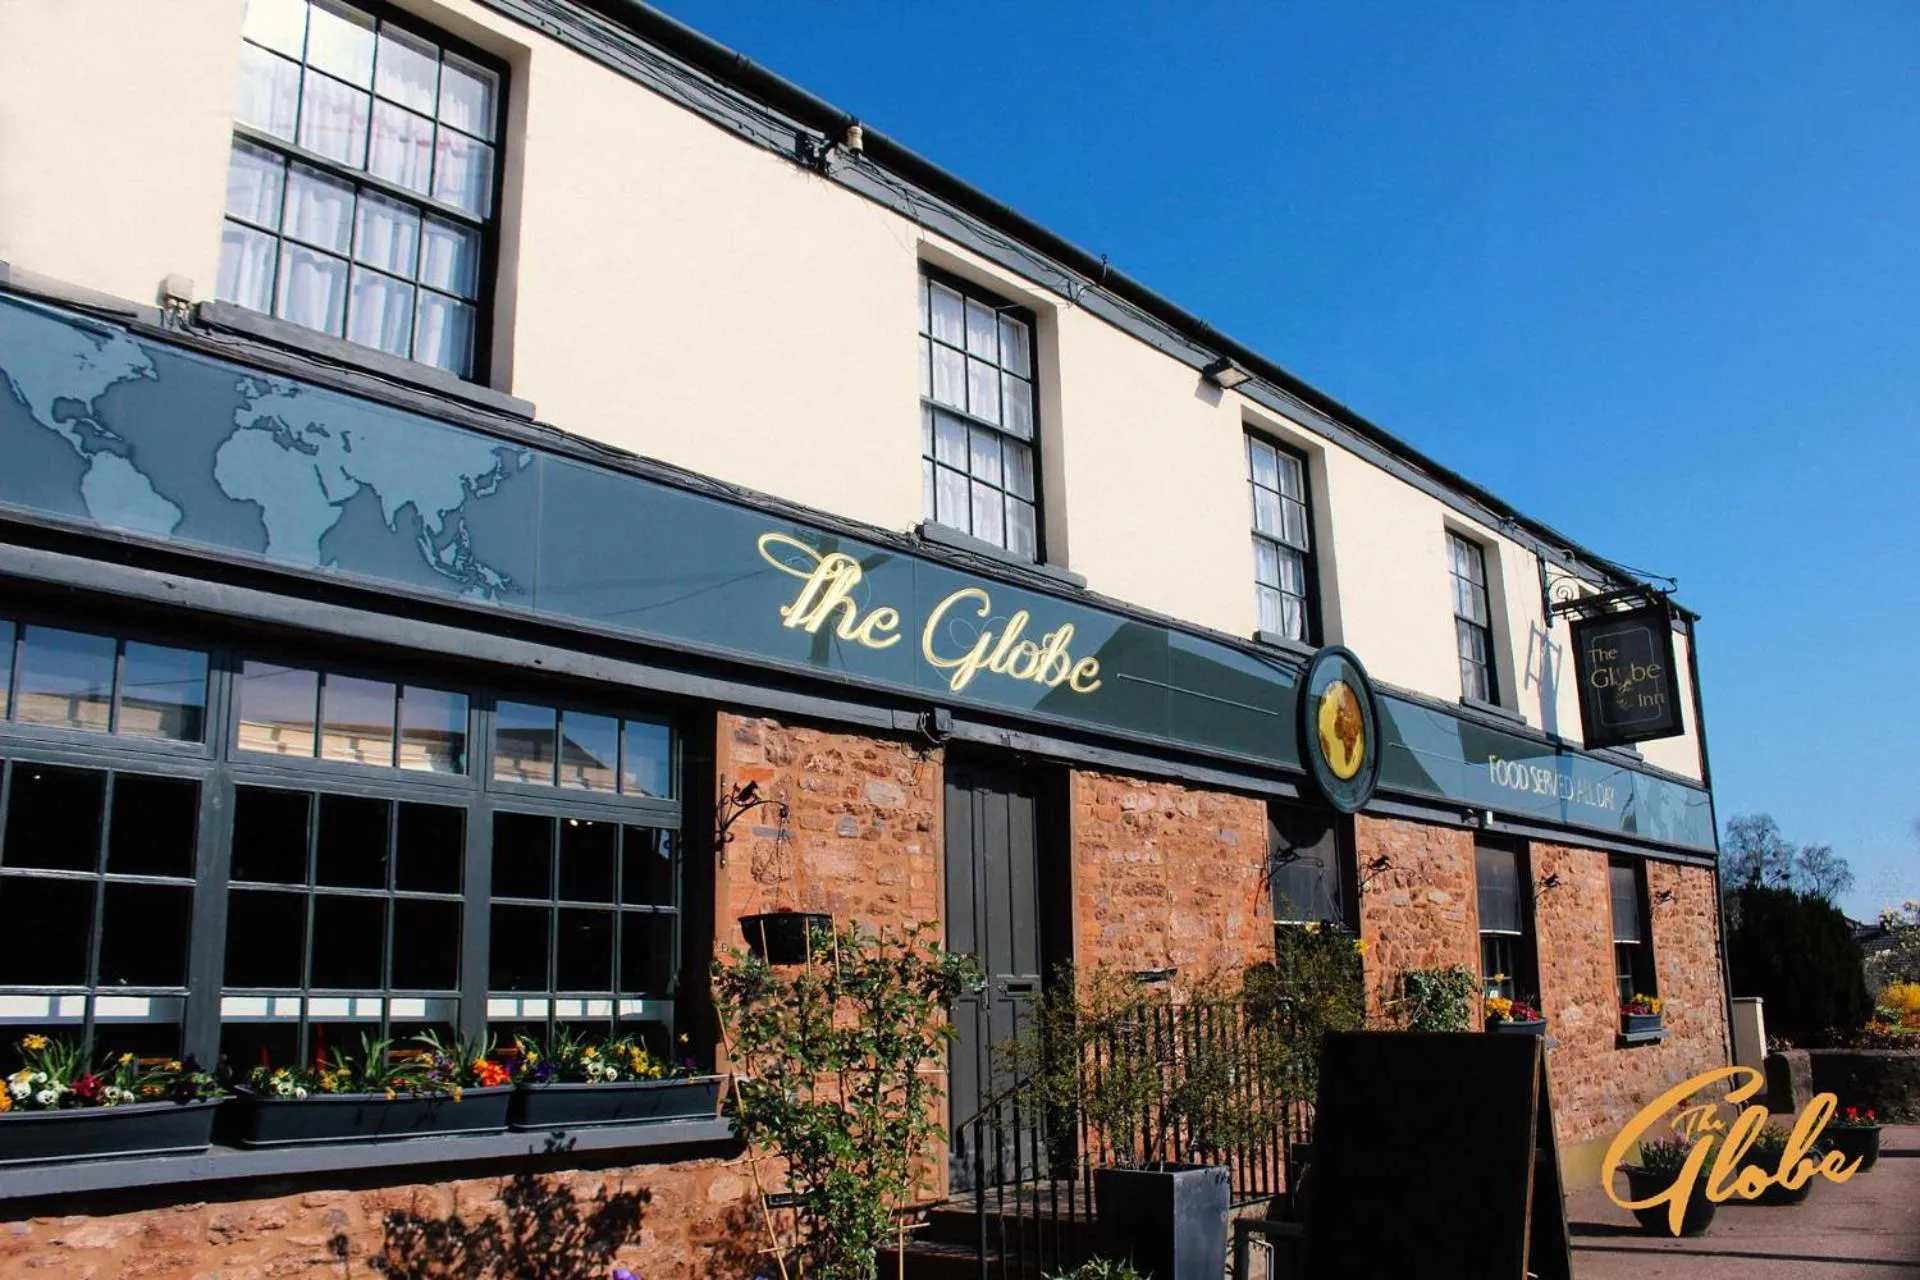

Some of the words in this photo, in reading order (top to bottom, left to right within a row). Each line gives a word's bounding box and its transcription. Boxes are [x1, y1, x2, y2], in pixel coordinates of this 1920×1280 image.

[758, 533, 901, 649] The
[922, 588, 1102, 692] Globe
[1588, 647, 1618, 663] The
[1638, 693, 1665, 708] Inn
[1488, 754, 1530, 790] FOOD
[1530, 766, 1574, 800] SERVED
